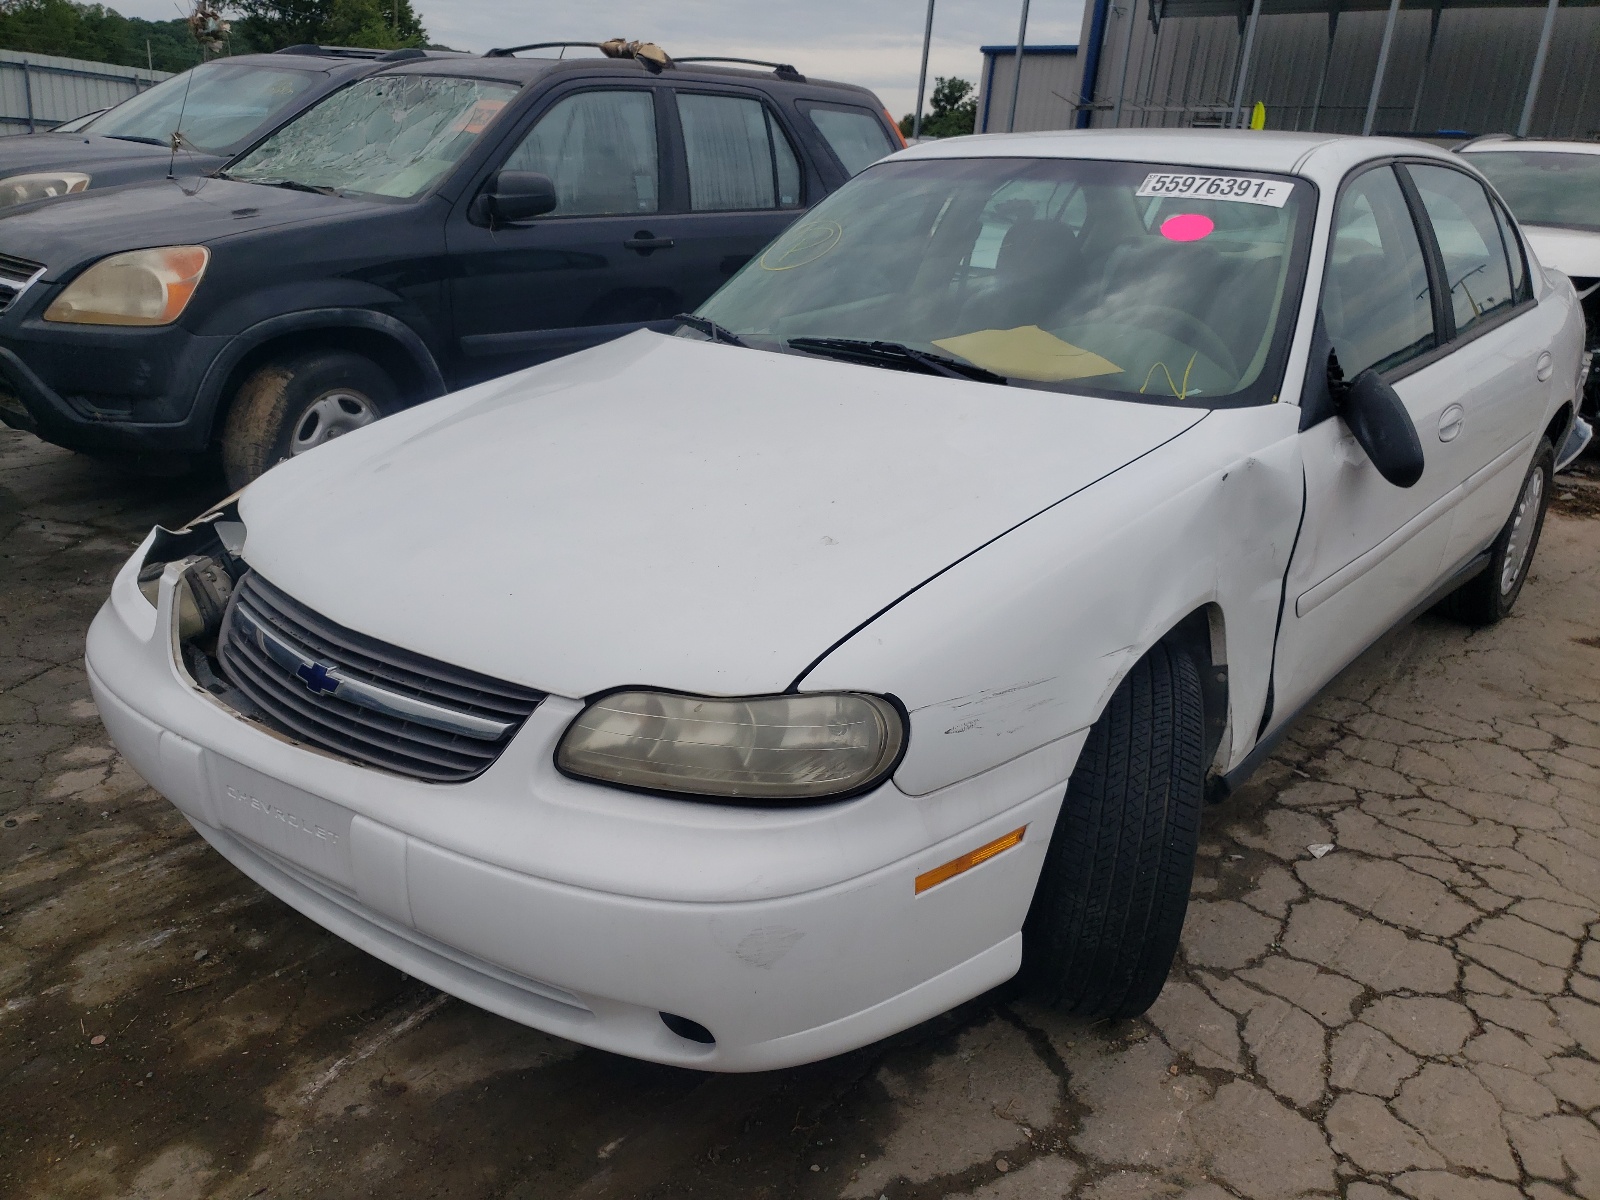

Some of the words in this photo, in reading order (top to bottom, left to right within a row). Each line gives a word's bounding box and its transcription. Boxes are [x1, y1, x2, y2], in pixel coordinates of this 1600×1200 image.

[1151, 175, 1265, 198] 55976391
[1264, 188, 1276, 198] F
[226, 784, 340, 844] CHEVROLET
